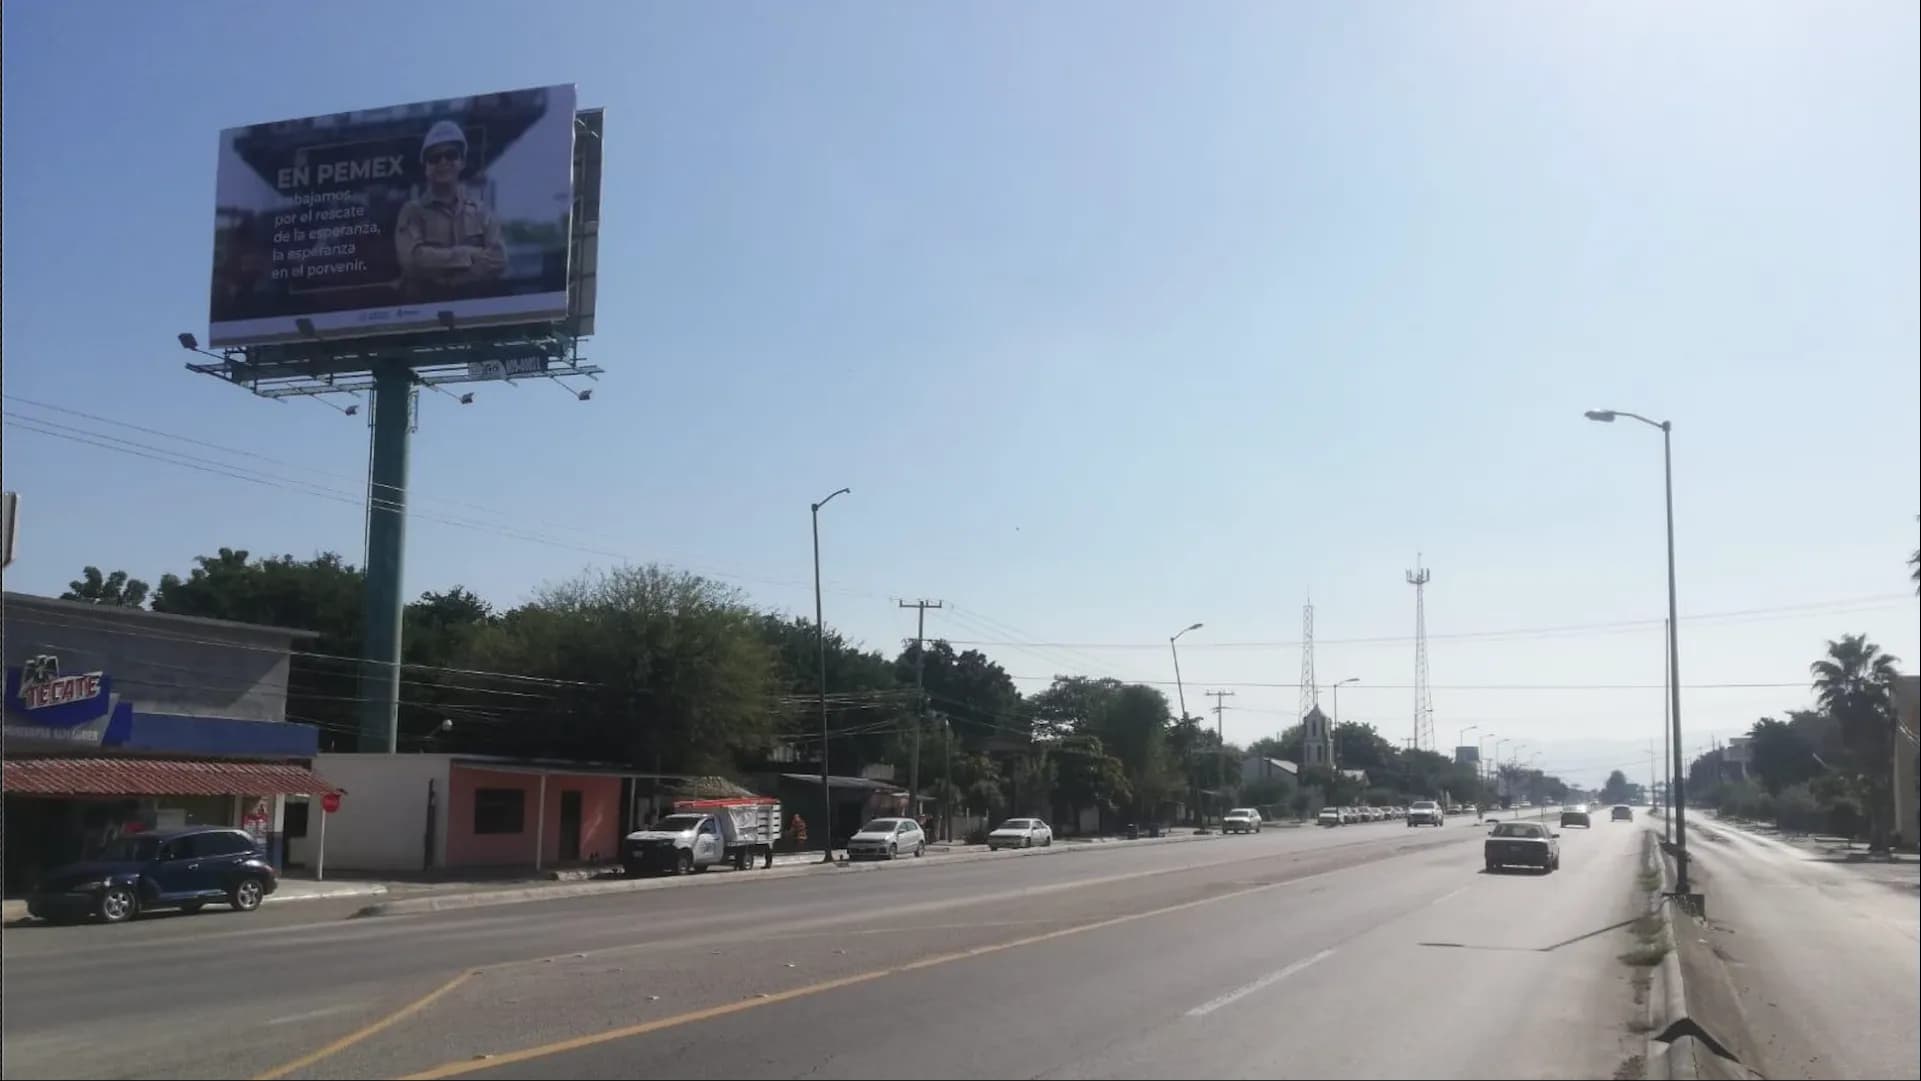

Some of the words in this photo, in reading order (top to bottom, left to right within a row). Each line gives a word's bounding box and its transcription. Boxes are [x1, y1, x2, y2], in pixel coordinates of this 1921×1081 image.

[277, 166, 310, 189] EN
[317, 154, 404, 185] PEMEX
[274, 214, 297, 229] por
[299, 209, 312, 224] el
[315, 206, 365, 221] rescate
[273, 230, 290, 244] de
[294, 227, 306, 241] la
[309, 223, 381, 241] esperanza,
[272, 247, 284, 262] la
[287, 243, 356, 261] esperanza
[271, 267, 288, 280] en
[291, 263, 304, 278] el
[307, 258, 368, 279] porvenir.
[26, 676, 102, 708] TECATE
